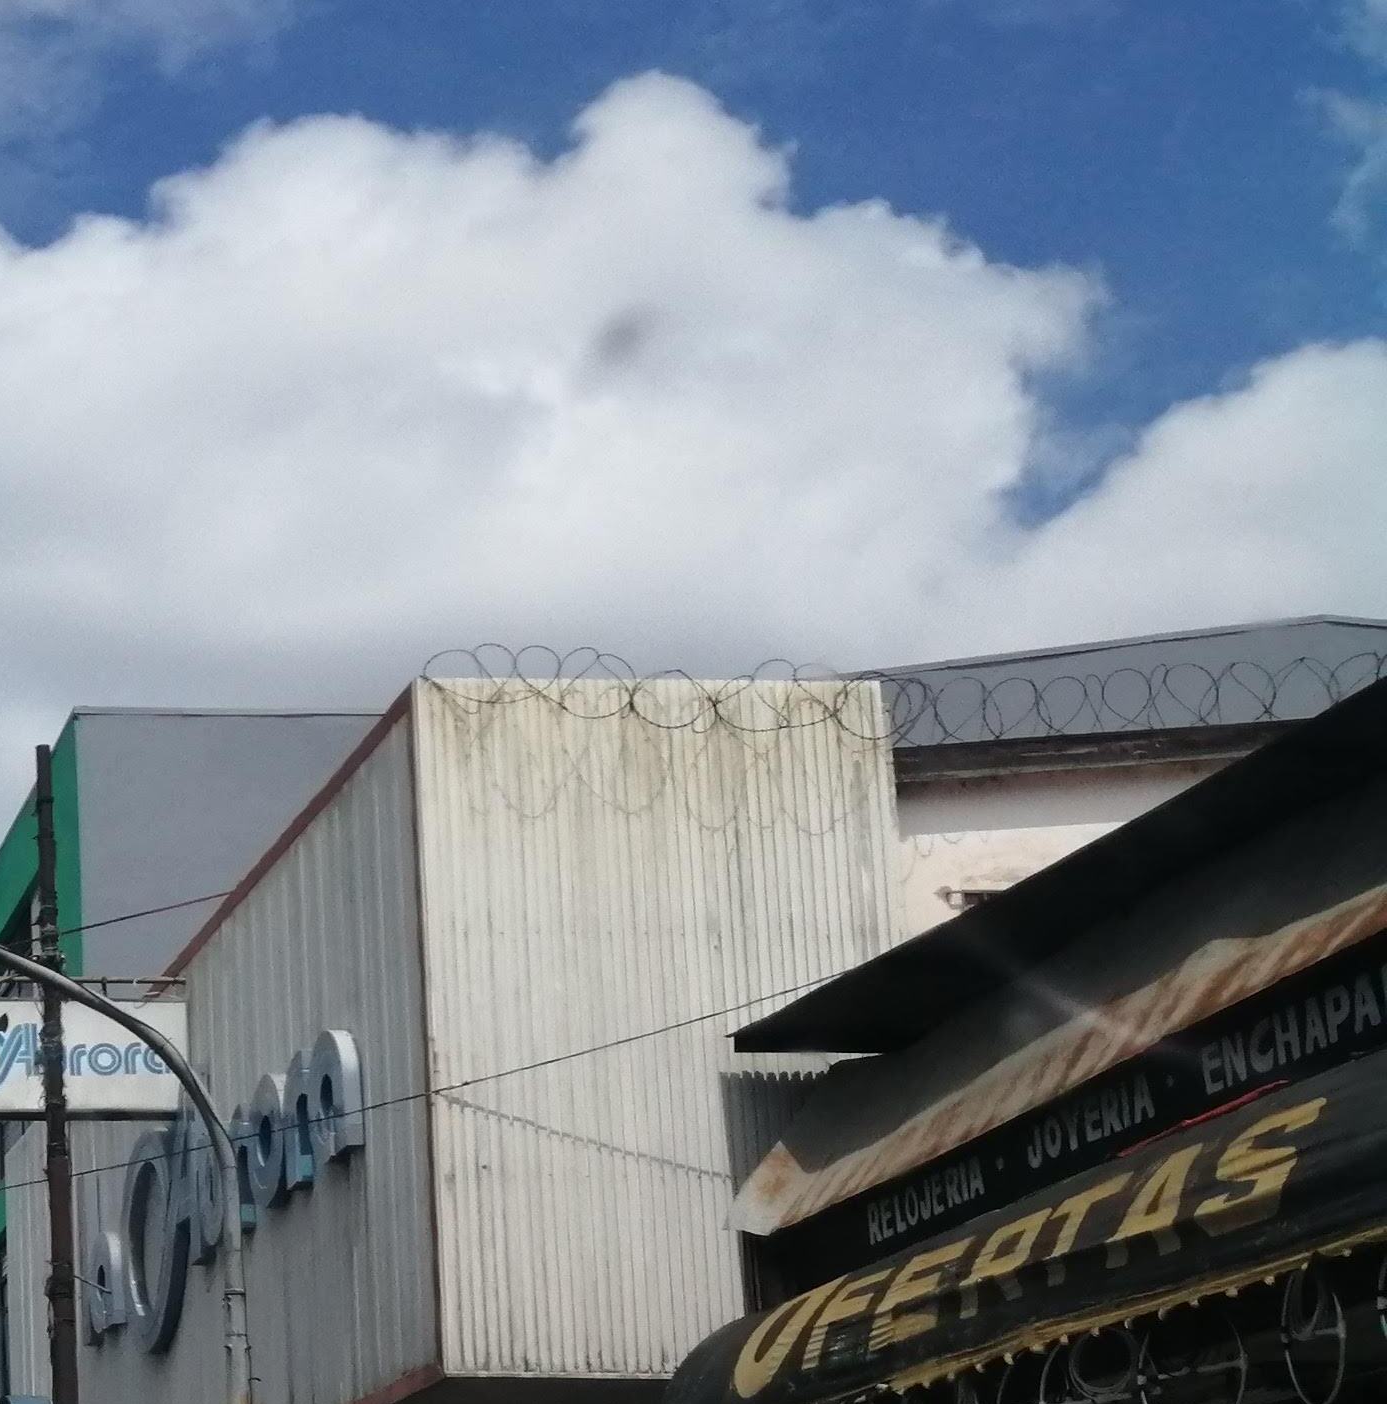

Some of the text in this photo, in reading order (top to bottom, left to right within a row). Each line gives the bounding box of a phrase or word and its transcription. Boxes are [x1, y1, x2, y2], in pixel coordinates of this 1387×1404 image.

[733, 1096, 1328, 1398] OFERTAS
[866, 1155, 986, 1246] RELOJERIA
[1027, 1078, 1157, 1170] JOYERIA
